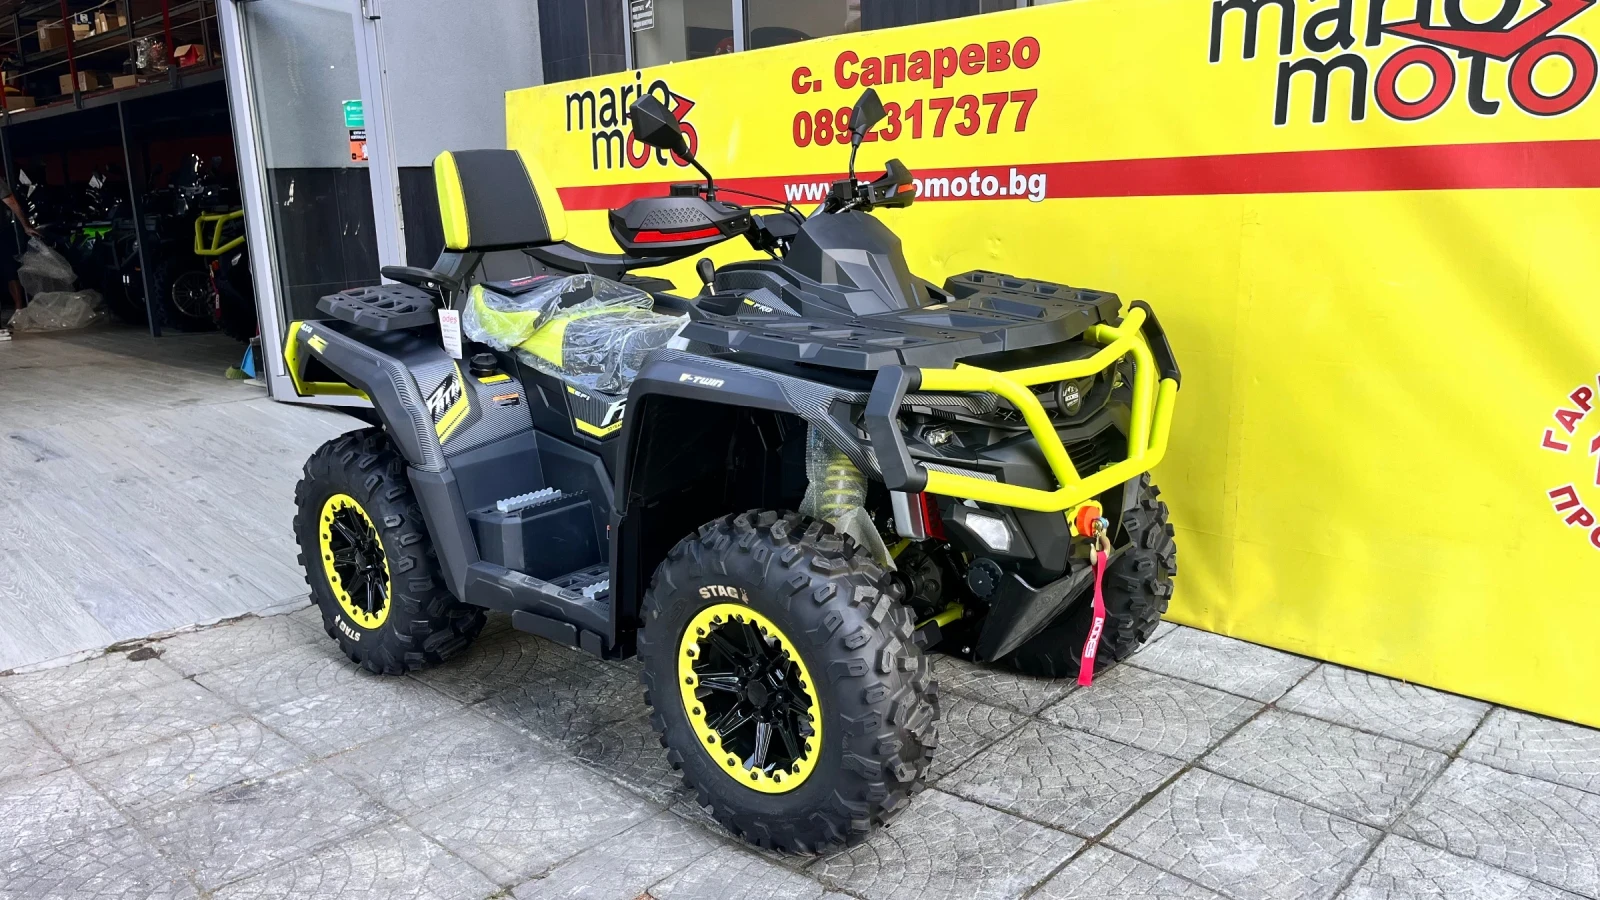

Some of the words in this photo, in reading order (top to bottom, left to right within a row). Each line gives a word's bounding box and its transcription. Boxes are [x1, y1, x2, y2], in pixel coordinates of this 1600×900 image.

[834, 36, 1040, 89] Сапарево
[1274, 35, 1598, 125] moto
[792, 89, 1038, 148] 089317377
[1543, 375, 1600, 451] ГАР
[699, 585, 739, 600] STAG
